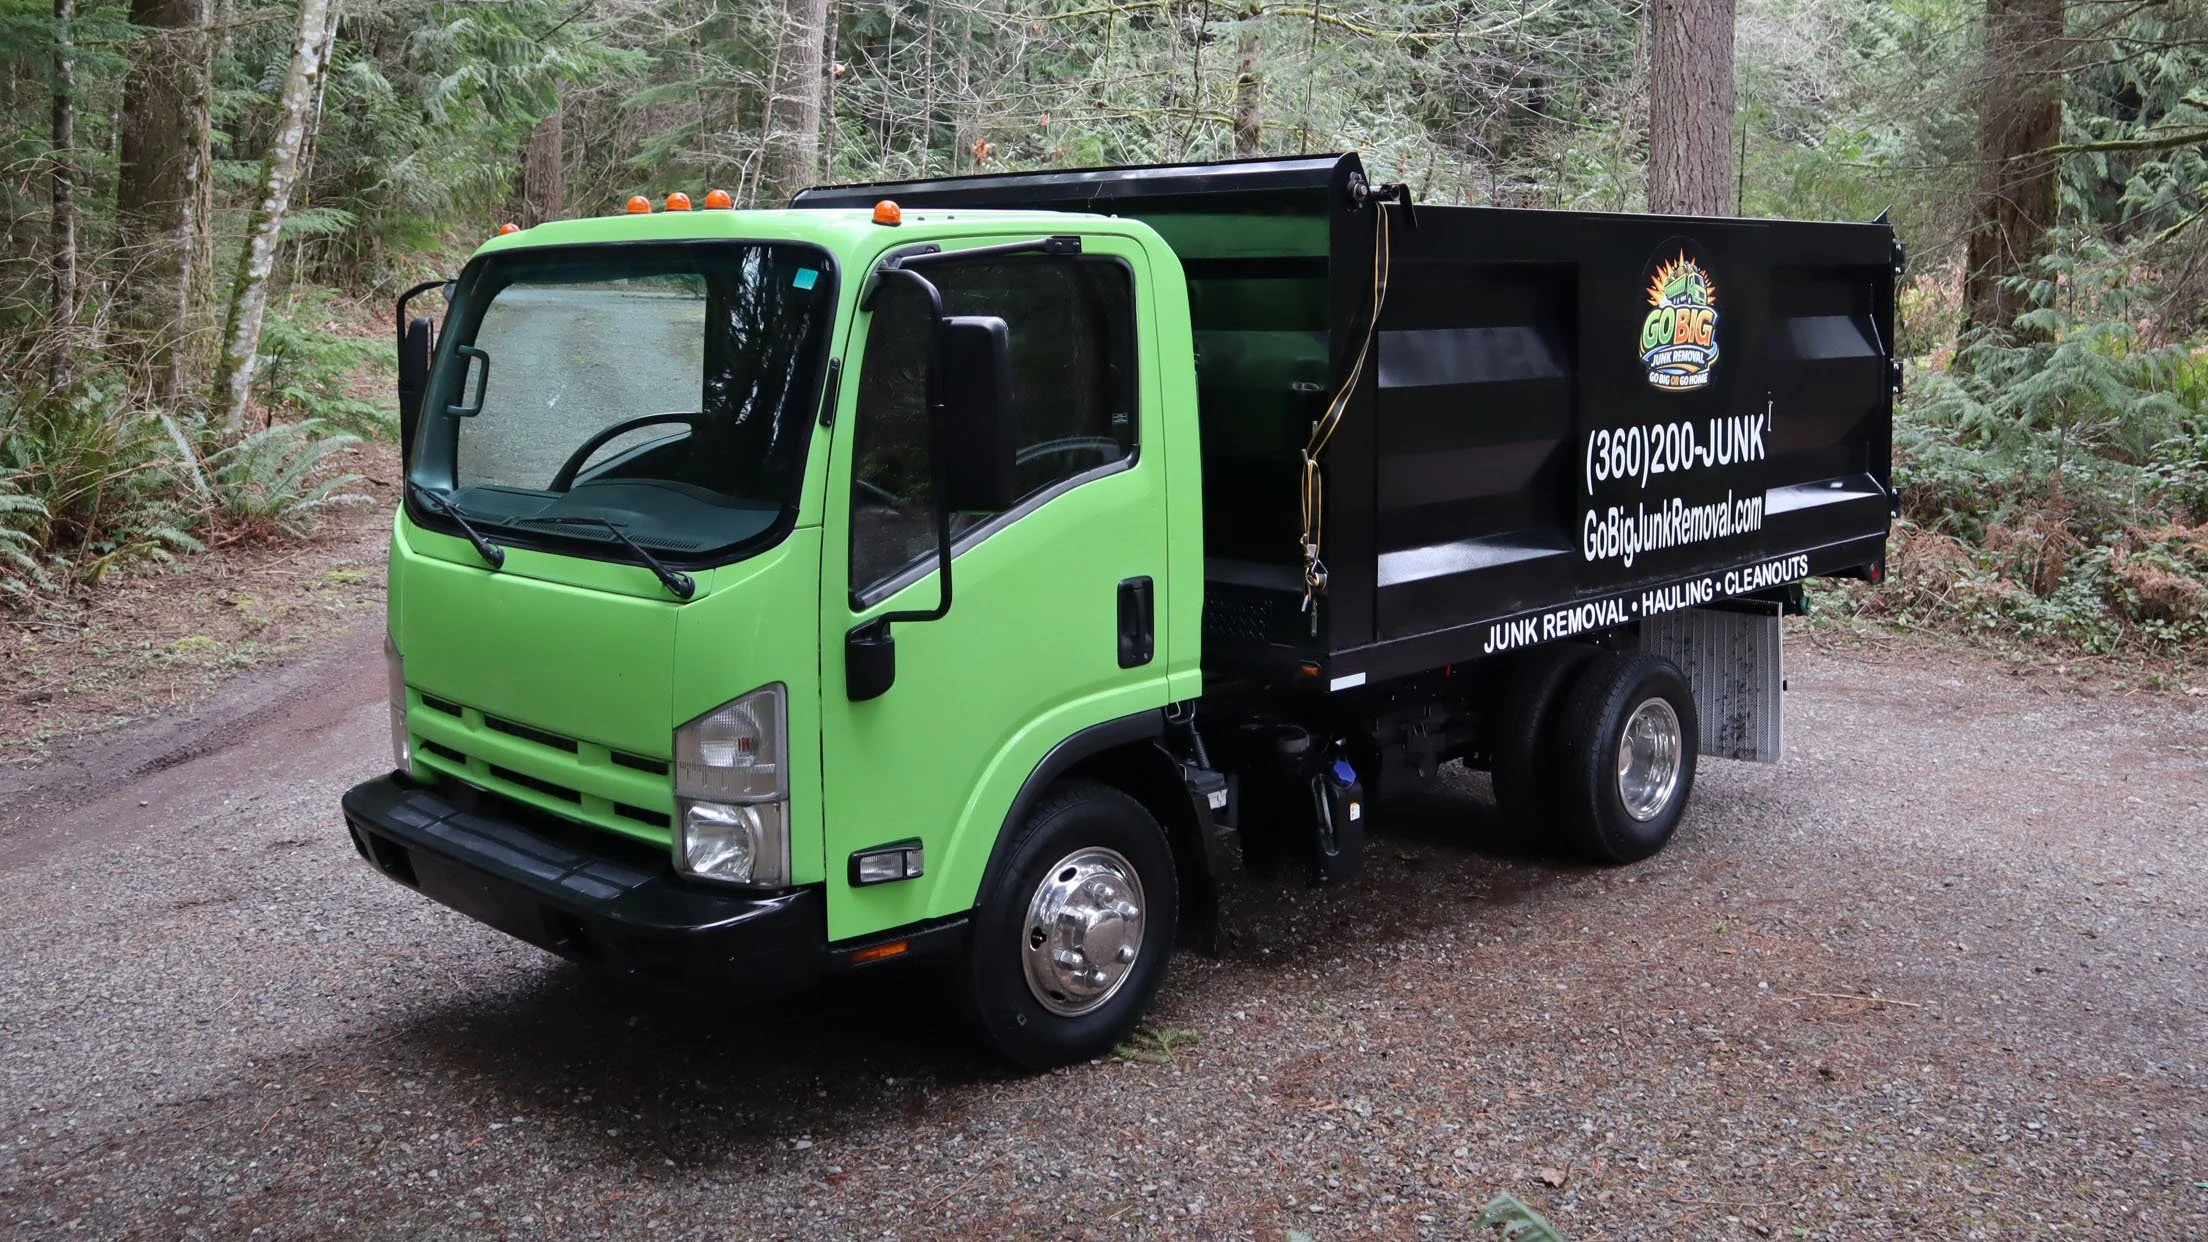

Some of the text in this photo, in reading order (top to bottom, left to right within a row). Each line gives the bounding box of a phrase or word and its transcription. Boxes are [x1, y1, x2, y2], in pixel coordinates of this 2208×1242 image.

[1649, 372, 1708, 386] GO BIG OR GO HOME
[1651, 350, 1704, 367] JUNK REMOVAL
[1586, 414, 1765, 495] (360)200-JUNK
[1583, 489, 1763, 568] GoBigJunkRemoval.com
[1484, 553, 1809, 655] JUNK REMOVAL HAULING CLEANOUTS
